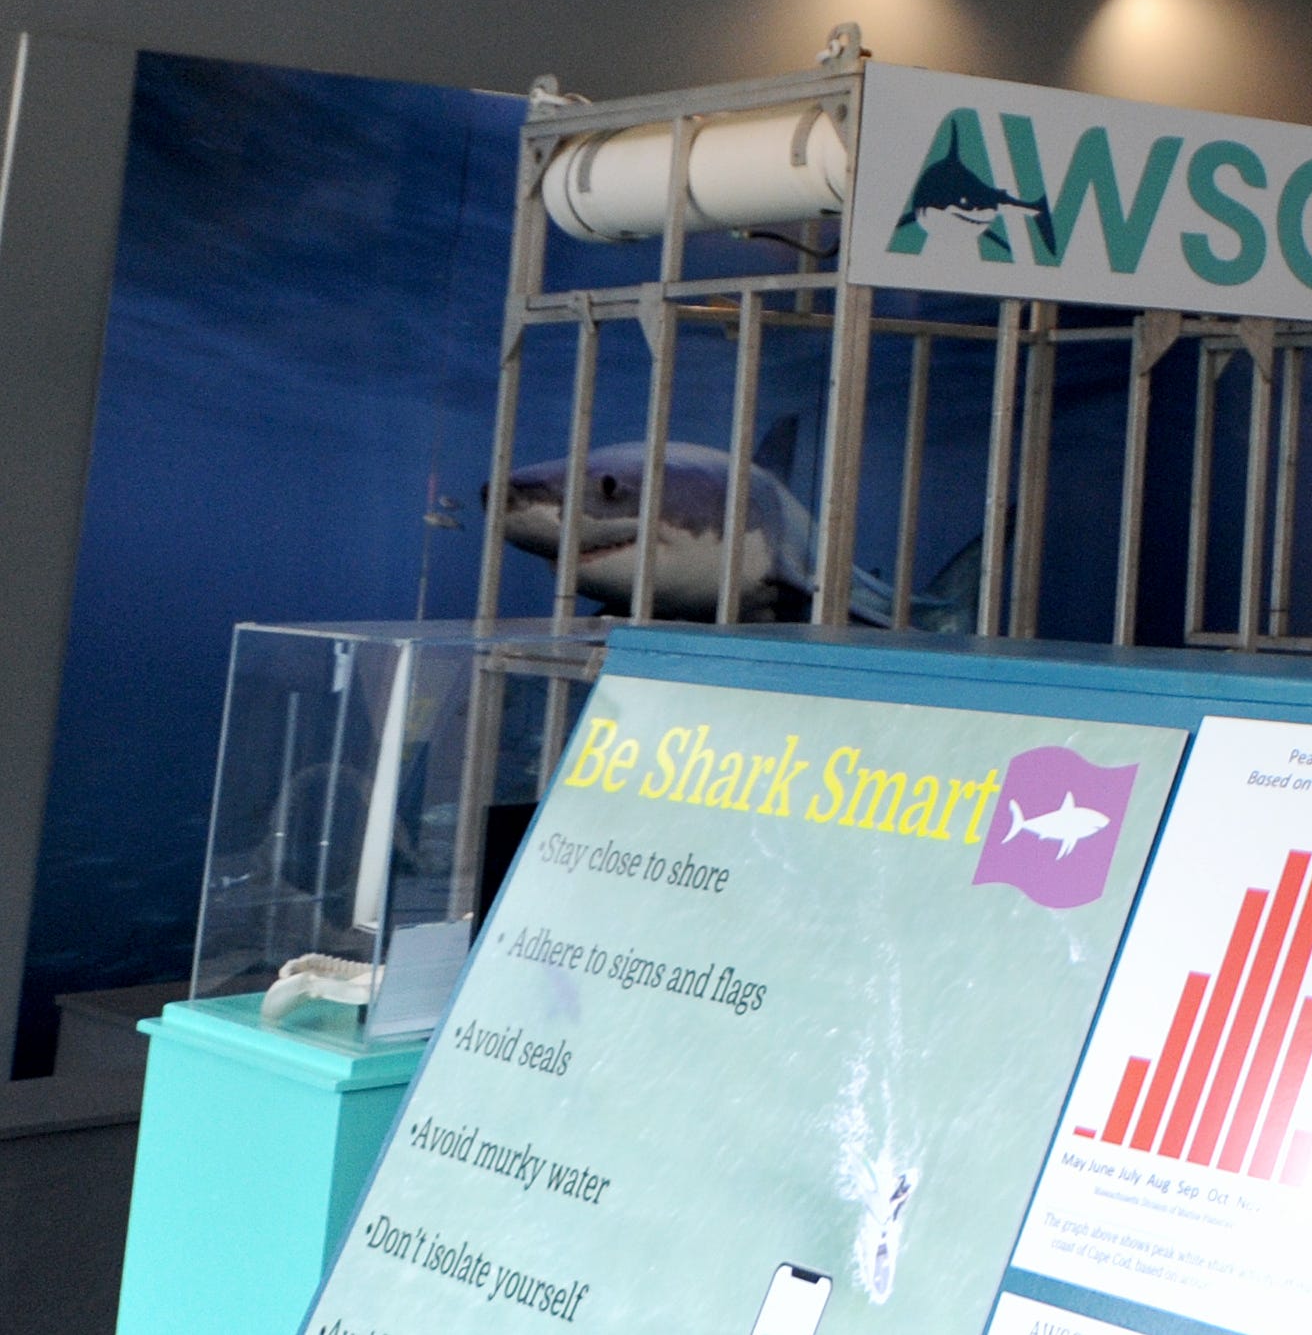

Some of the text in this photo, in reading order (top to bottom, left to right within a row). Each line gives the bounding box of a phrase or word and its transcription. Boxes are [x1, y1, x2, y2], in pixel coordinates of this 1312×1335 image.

[565, 718, 1002, 844] Be Shark Smart
[1248, 771, 1290, 789] Based
[1292, 777, 1312, 790] on
[541, 833, 730, 893] Stay close to shore
[508, 926, 767, 1015] Adhere to signs and flags
[456, 1019, 572, 1076] Avoid seals
[412, 1117, 610, 1204] Avoid murky water
[1061, 1153, 1088, 1173] May
[1086, 1160, 1116, 1176] June
[1117, 1169, 1143, 1185] July
[1146, 1173, 1172, 1194] Aug
[1176, 1180, 1200, 1199] Sep
[1207, 1188, 1228, 1206] Oct
[367, 1215, 589, 1323] Don't isolate yourself
